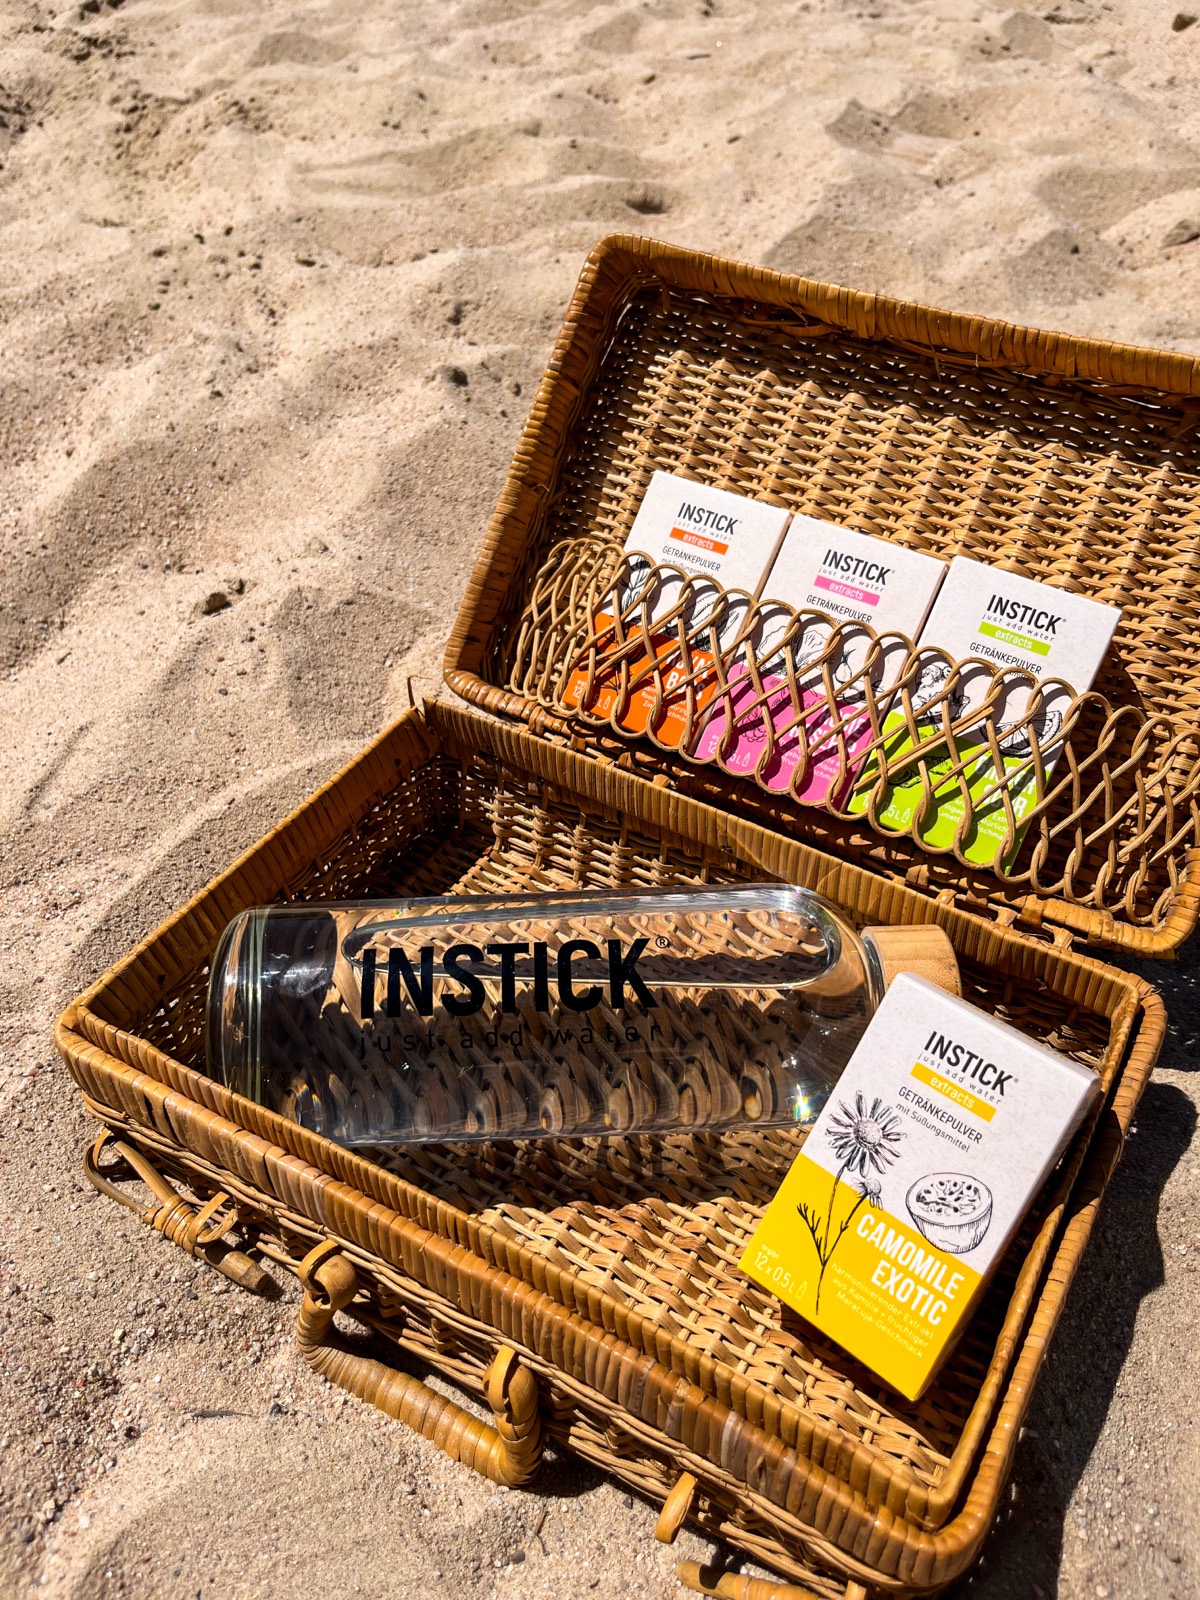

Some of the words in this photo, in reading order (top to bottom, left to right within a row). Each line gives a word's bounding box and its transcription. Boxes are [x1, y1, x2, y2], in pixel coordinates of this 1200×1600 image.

[673, 520, 690, 528] just
[693, 525, 706, 534] add
[710, 531, 732, 541] water
[678, 502, 739, 535] INSTICK
[662, 546, 721, 572] GETRÄNKEPULVER
[683, 534, 714, 550] extracts
[819, 568, 836, 577] just
[840, 575, 855, 583] add
[859, 581, 884, 593] water
[823, 549, 891, 586] INSTICK
[806, 595, 872, 623] GETRÄNKEPULVER
[829, 583, 863, 601] extracts
[982, 613, 1002, 623] just
[1006, 621, 1022, 631] add
[1027, 628, 1054, 642] water
[987, 594, 1062, 635] INSTICK
[995, 630, 1033, 649] extracts
[970, 642, 1042, 674] GETRÄNKEPULVER
[360, 1029, 437, 1059] just
[460, 1023, 524, 1050] add
[550, 1022, 661, 1047] water
[917, 1052, 941, 1069] just
[945, 1068, 965, 1084] add
[969, 1082, 1002, 1105] water
[924, 1031, 1013, 1097] INSTICK
[930, 1076, 975, 1109] extracts
[896, 1103, 910, 1115] mit
[911, 1110, 970, 1152] Süßungsmittel
[898, 1086, 983, 1144] GETRÄNKEPULVER
[754, 1251, 767, 1272] 12
[765, 1266, 772, 1275] x
[856, 1213, 965, 1300] CAMOMILE
[831, 1263, 902, 1316] harmonisierender
[903, 1312, 934, 1339] Extrakt
[870, 1260, 947, 1326] EXOTIC
[832, 1277, 847, 1291] aus
[848, 1287, 879, 1313] Kamille
[887, 1315, 929, 1348] fruchtiger
[836, 1290, 923, 1358] Maracuja-Geschmack
